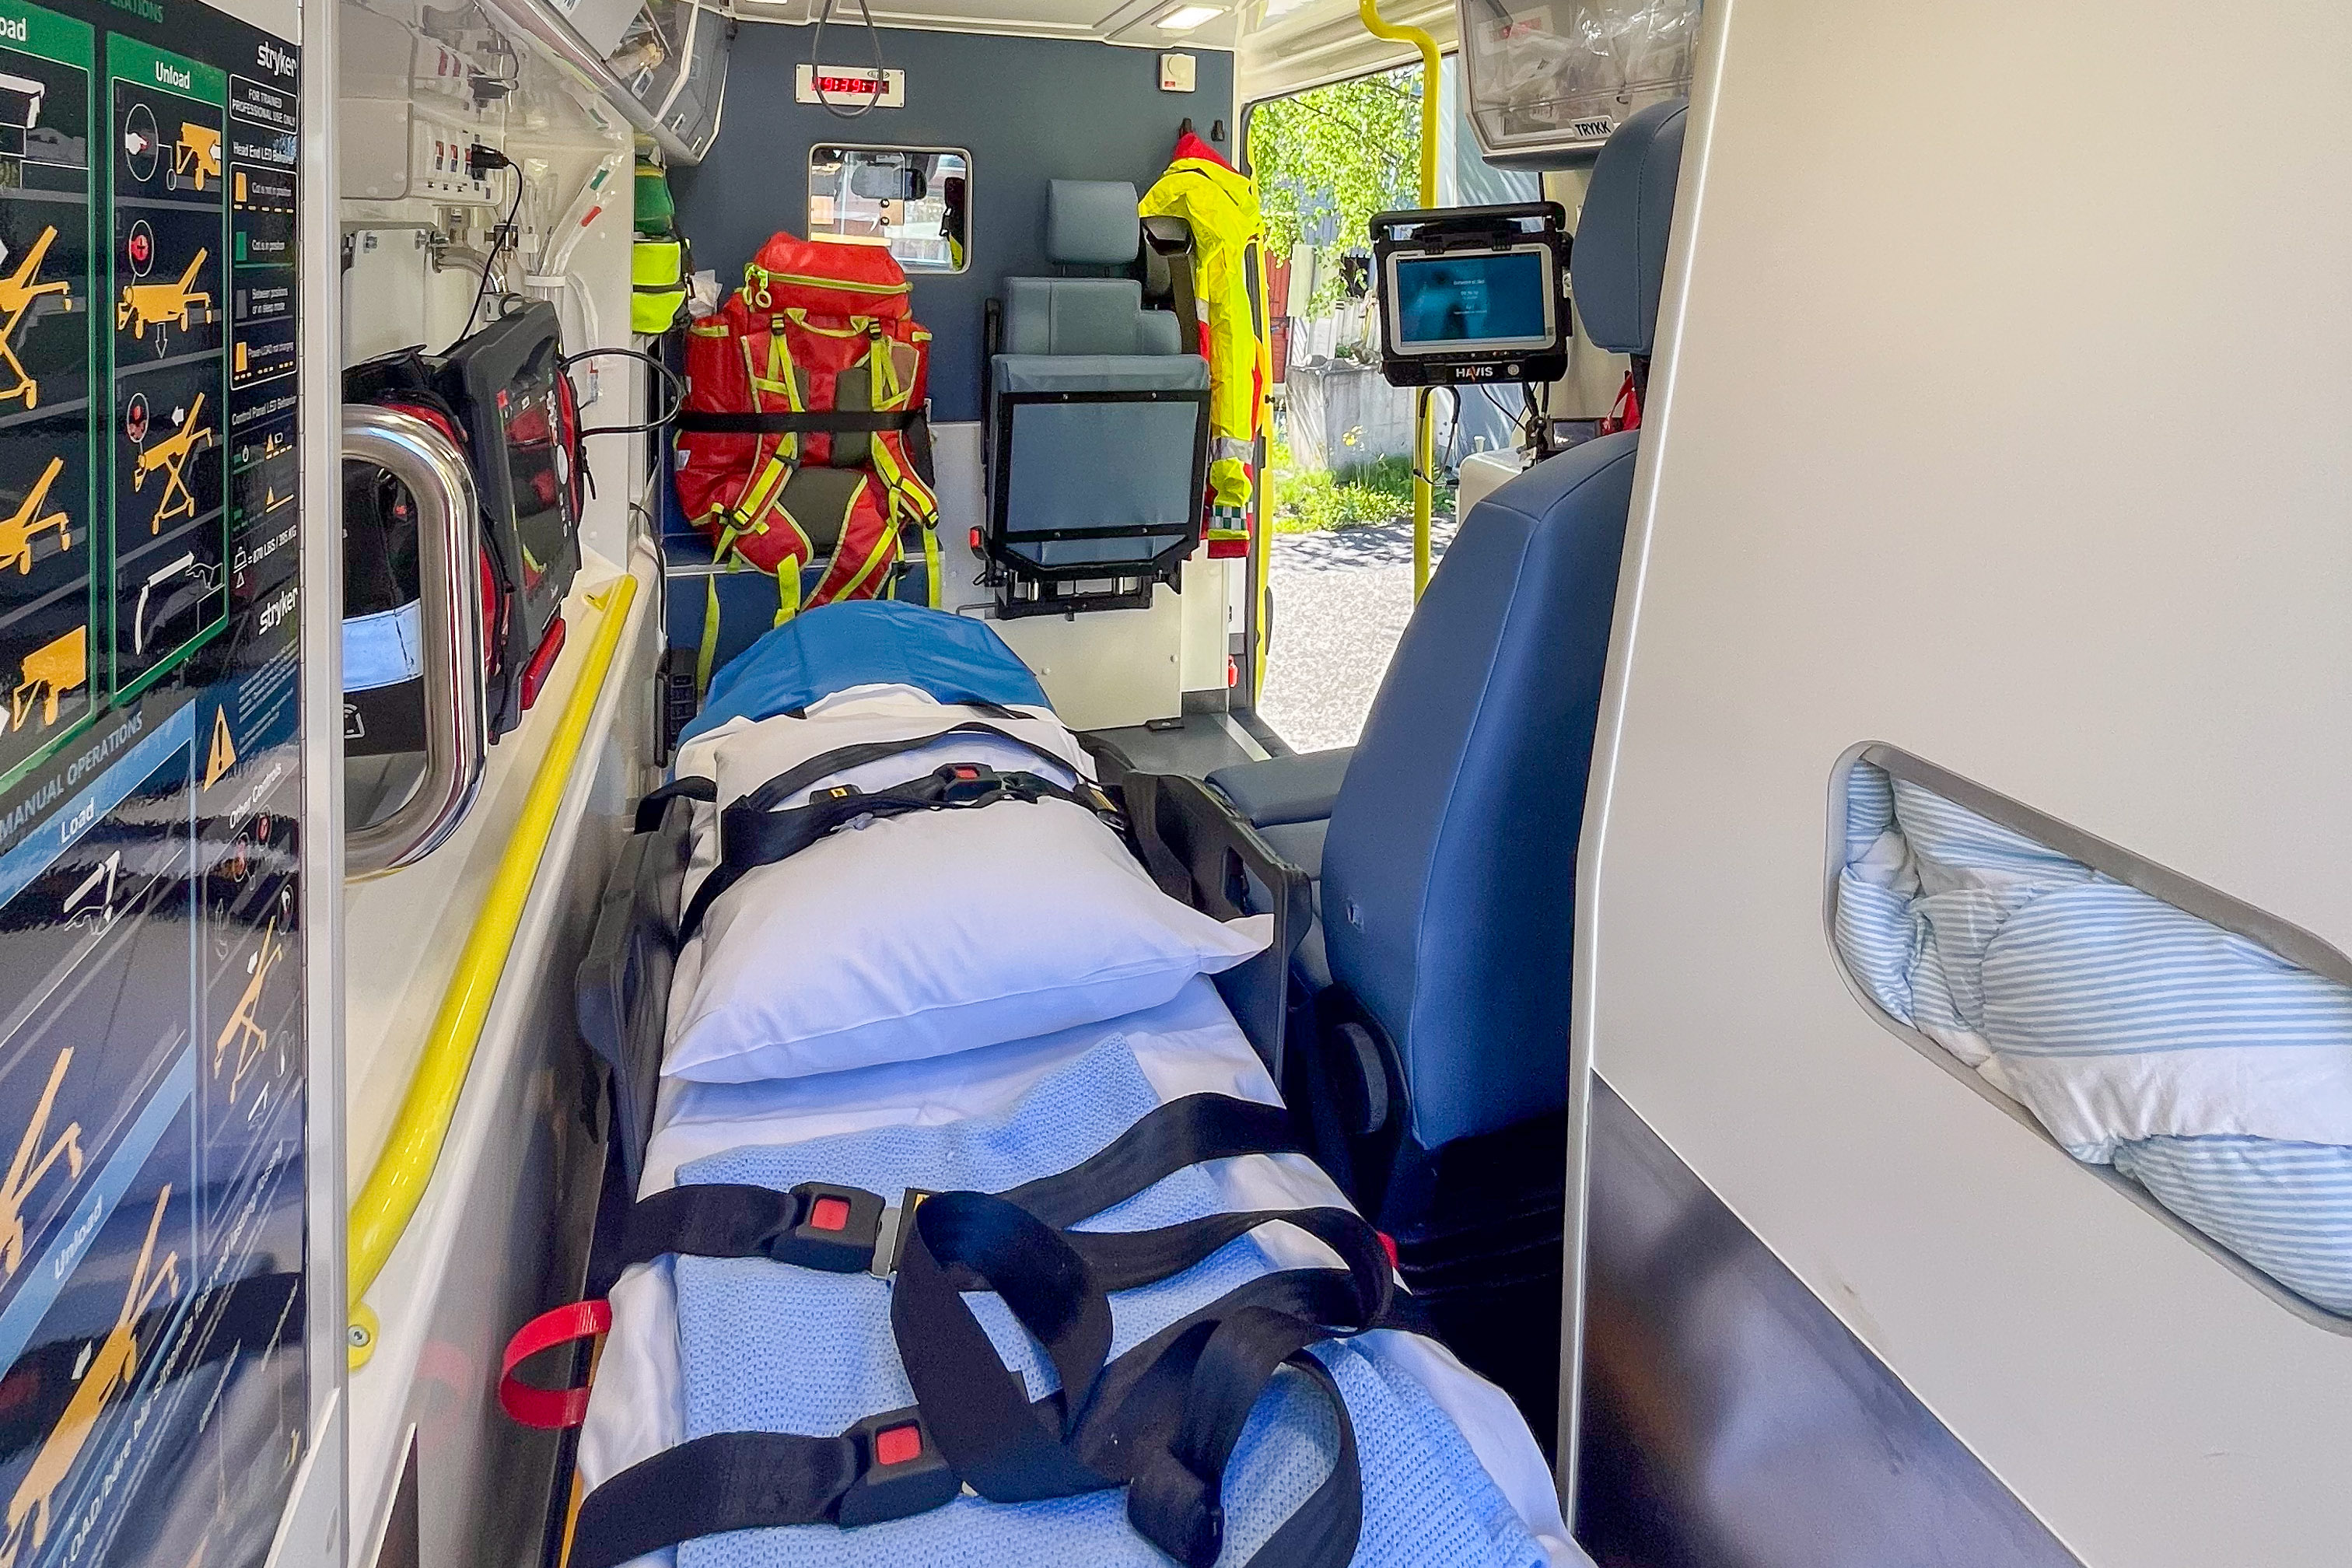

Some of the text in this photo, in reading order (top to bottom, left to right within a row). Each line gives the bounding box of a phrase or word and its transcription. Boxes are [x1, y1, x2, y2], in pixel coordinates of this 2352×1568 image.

[0, 16, 26, 42] oad
[156, 60, 191, 89] Unload
[257, 41, 296, 77] stryker
[1574, 121, 1612, 136] TRYKK
[1456, 366, 1493, 379] HAVIS
[264, 538, 275, 556] LBS
[258, 587, 298, 635] stryker
[0, 710, 142, 841] MANUAL OPERATIONS
[229, 796, 251, 829] Other
[252, 762, 282, 803] Controls
[61, 796, 95, 844] Load
[54, 1194, 103, 1280] Unload
